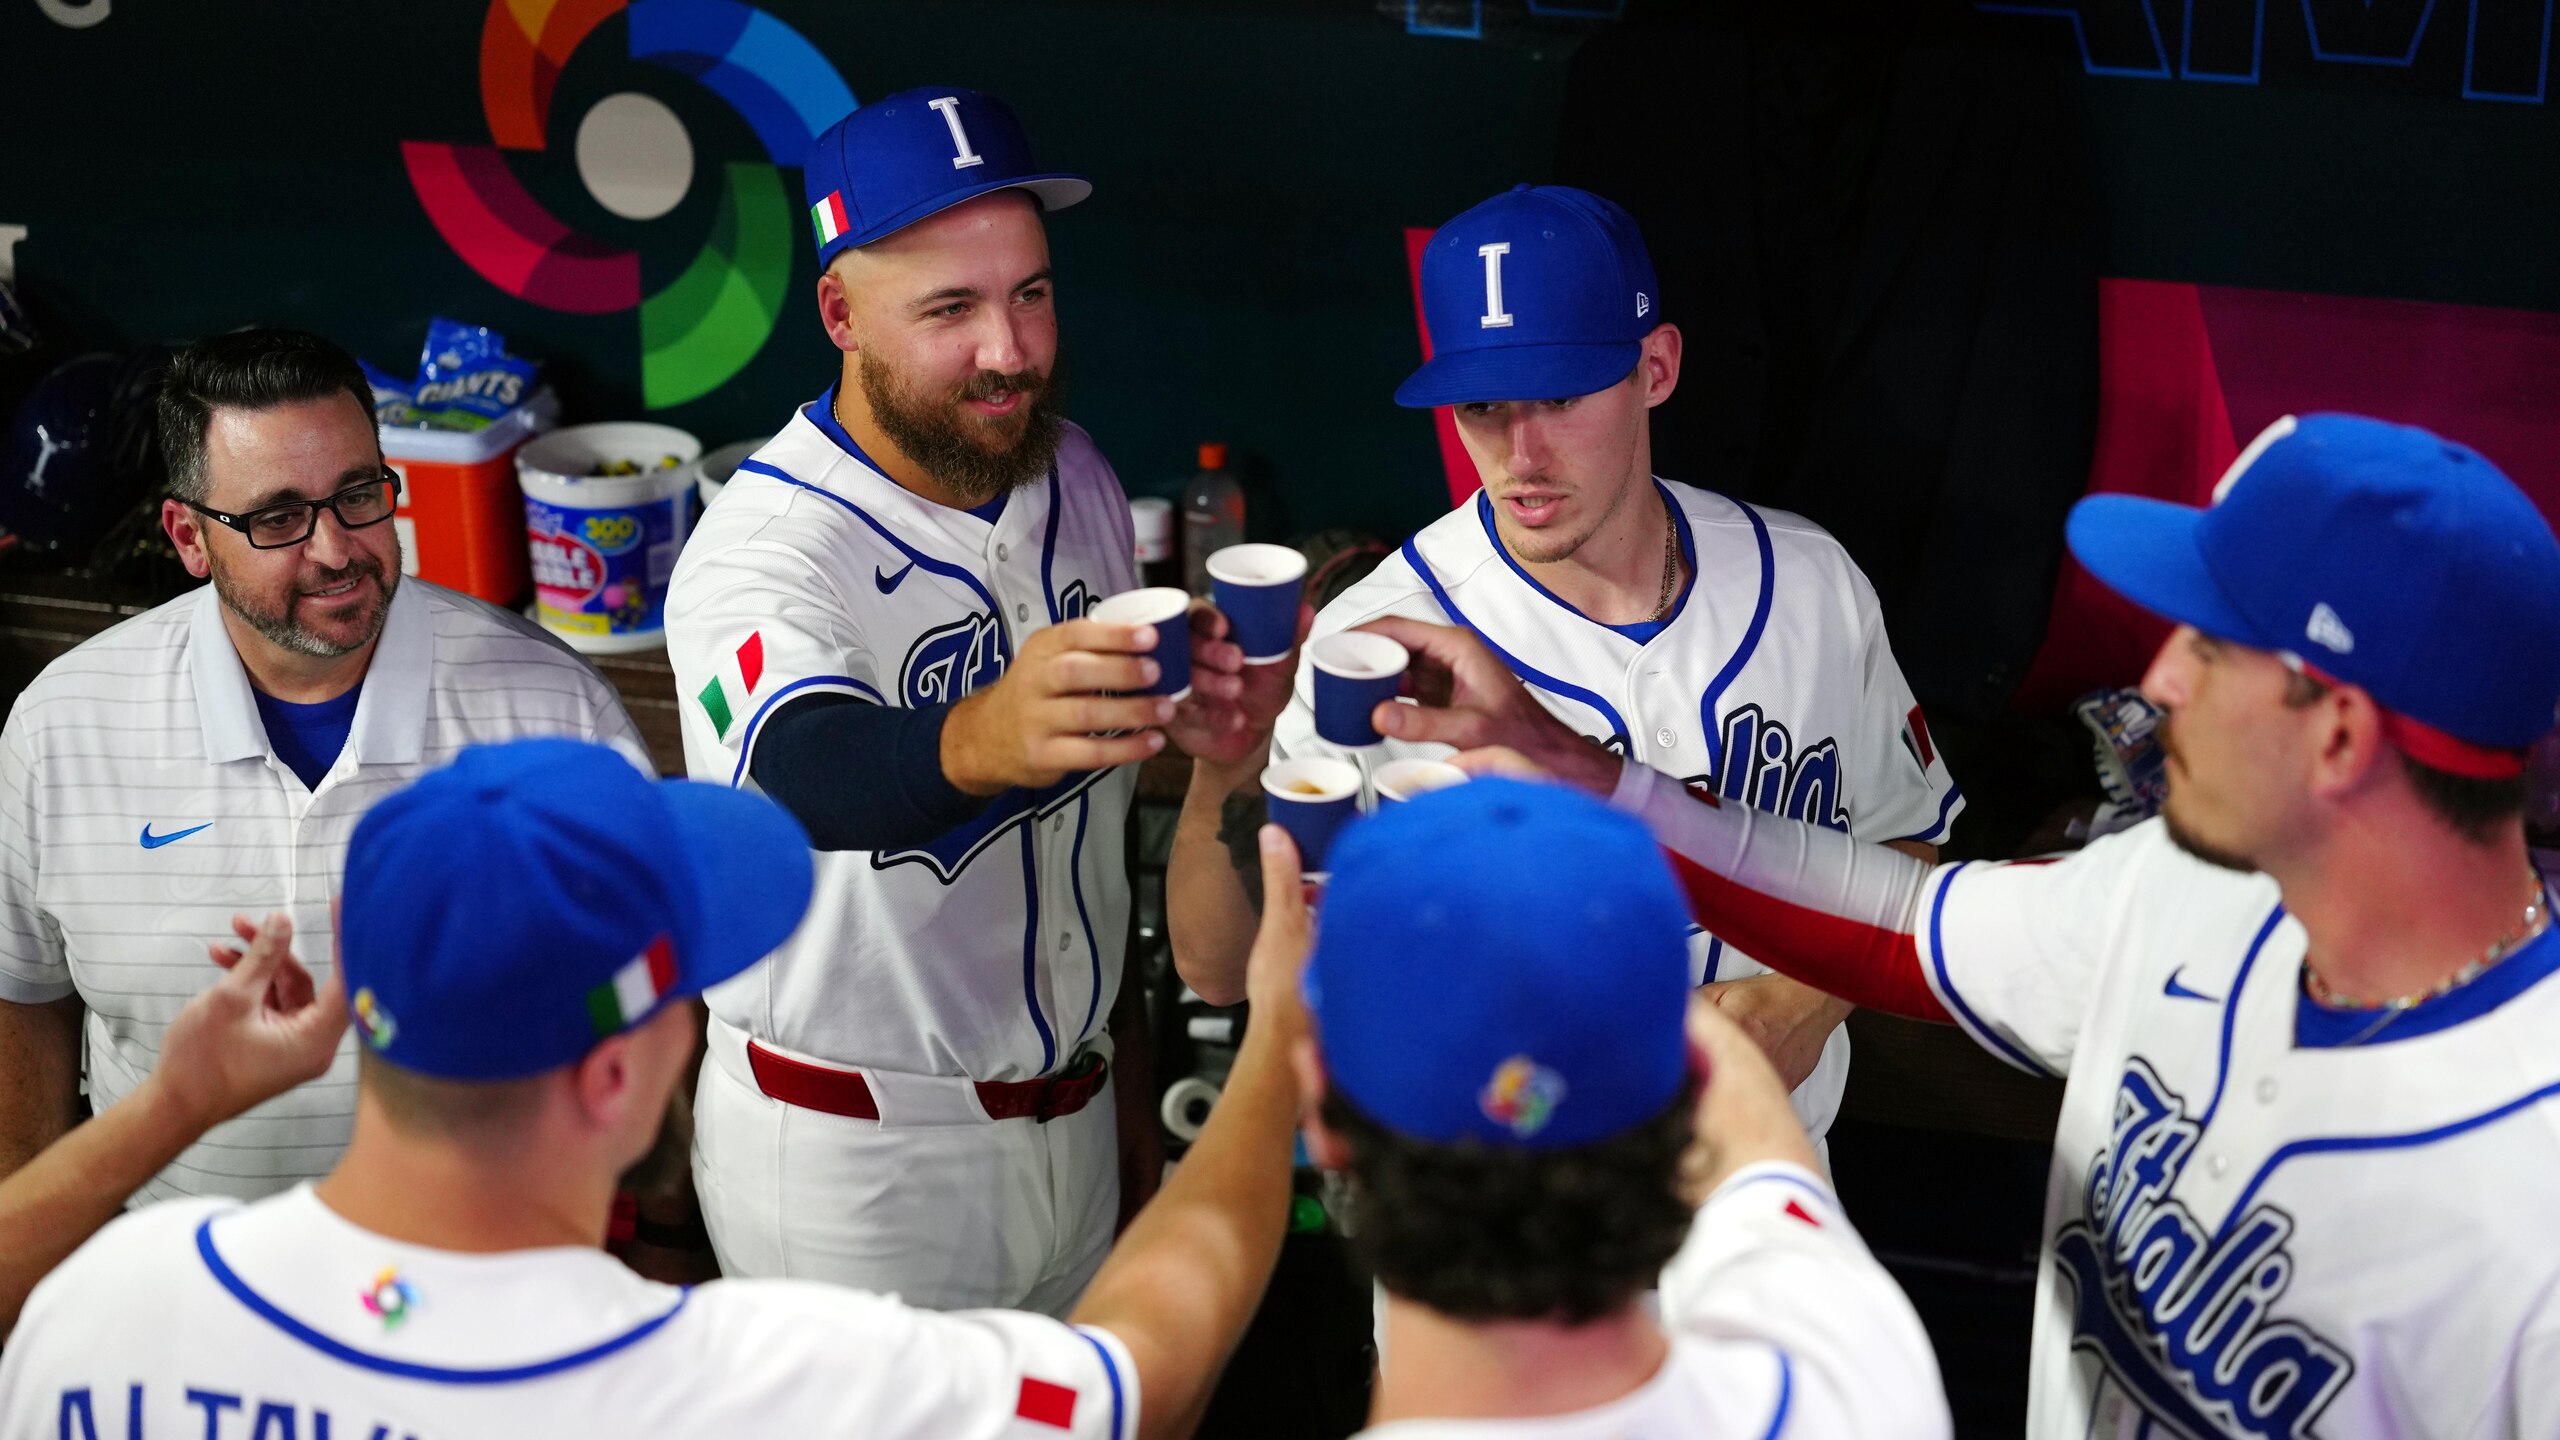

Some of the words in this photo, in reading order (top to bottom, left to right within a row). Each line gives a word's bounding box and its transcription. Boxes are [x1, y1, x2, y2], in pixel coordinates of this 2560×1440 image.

[928, 96, 984, 170] I
[1478, 242, 1514, 329] I
[2084, 1056, 2355, 1440] Italia
